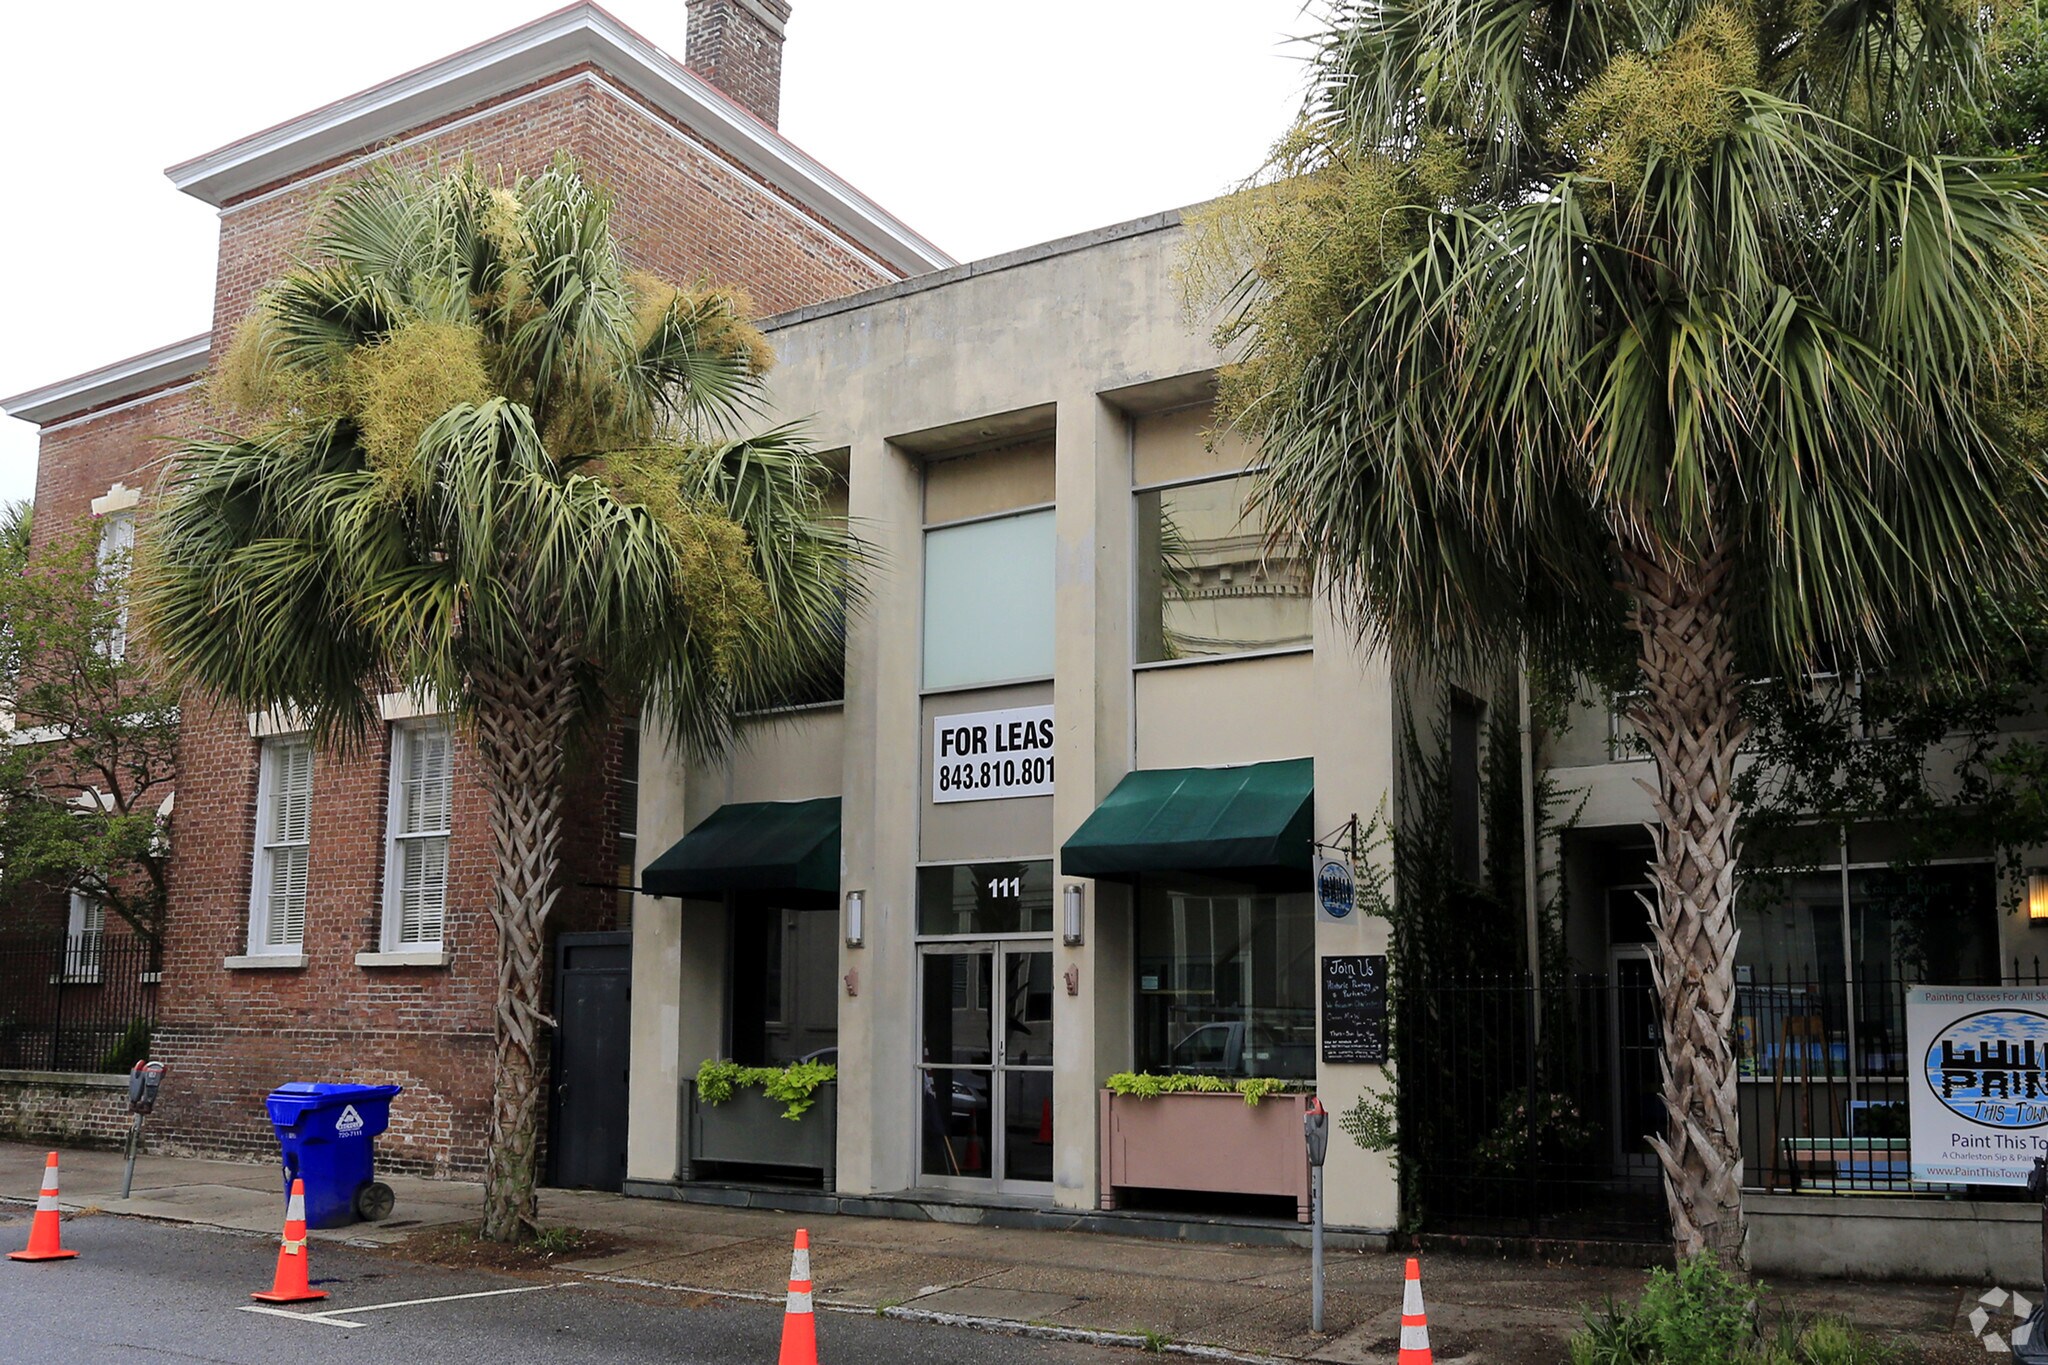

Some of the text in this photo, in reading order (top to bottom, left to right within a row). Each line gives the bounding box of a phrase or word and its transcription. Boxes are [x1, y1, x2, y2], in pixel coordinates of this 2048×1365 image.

[941, 719, 1054, 757] FOR LEAS
[939, 756, 1054, 791] 843.810.801
[988, 877, 1020, 898] 111
[1330, 958, 1374, 977] Join Us
[1925, 992, 1964, 1004] Painting
[1966, 993, 2000, 1001] Classes
[2003, 993, 2018, 1001] For
[2021, 993, 2033, 1001] All
[338, 1130, 362, 1138] 720-7111
[1951, 1133, 2048, 1150] Paint This To
[1950, 1152, 1993, 1161] Charleston
[1995, 1153, 2007, 1162] Sip
[2017, 1154, 2036, 1162] Pain
[1927, 1167, 2029, 1179] www.PaintThisTown
